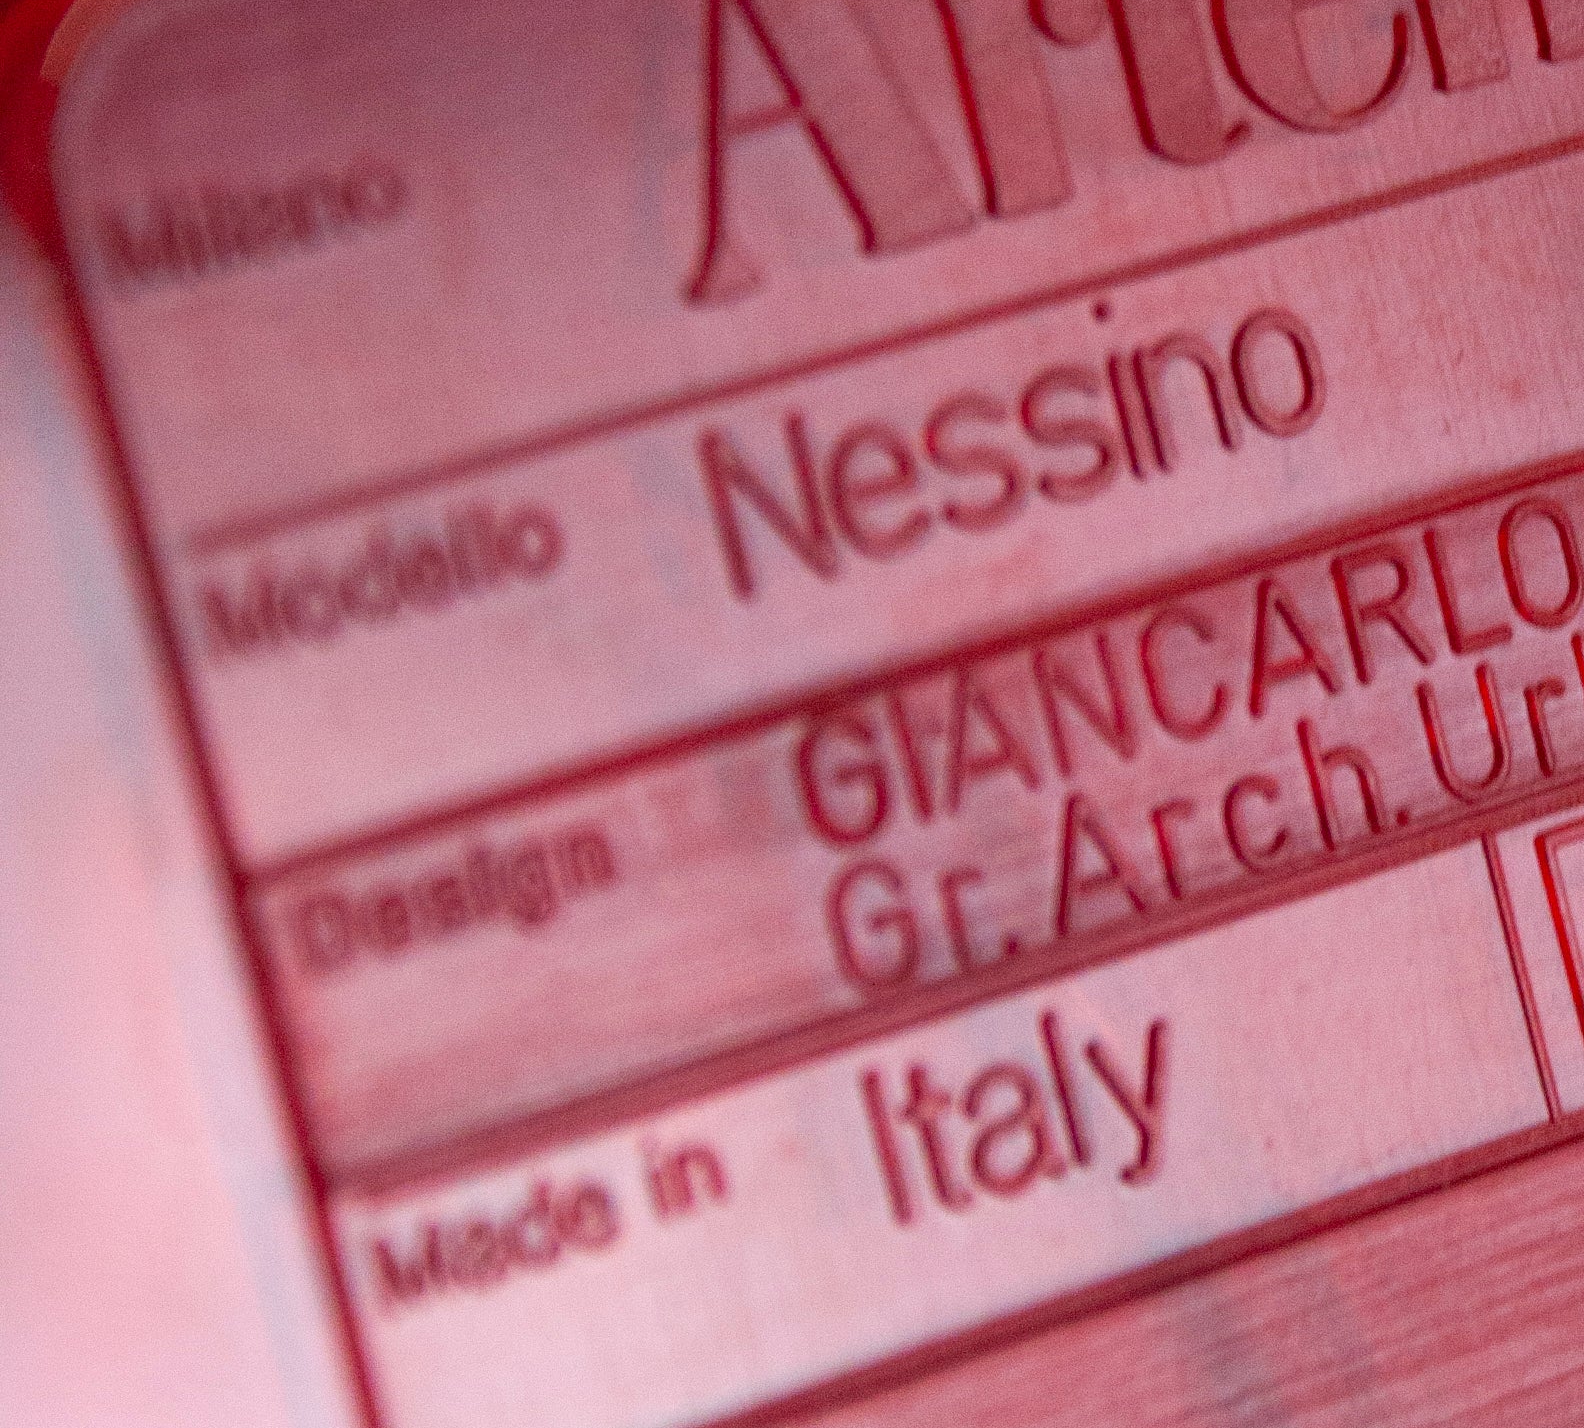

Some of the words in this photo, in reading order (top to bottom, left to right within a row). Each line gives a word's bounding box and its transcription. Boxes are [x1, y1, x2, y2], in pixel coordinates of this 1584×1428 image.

[104, 156, 405, 286] Milano
[698, 300, 1326, 603] Nessino
[202, 501, 563, 659] Modello
[288, 823, 617, 971] Design
[858, 1007, 1168, 1227] Italy
[370, 1177, 617, 1316] Made
[641, 1131, 728, 1221] in
